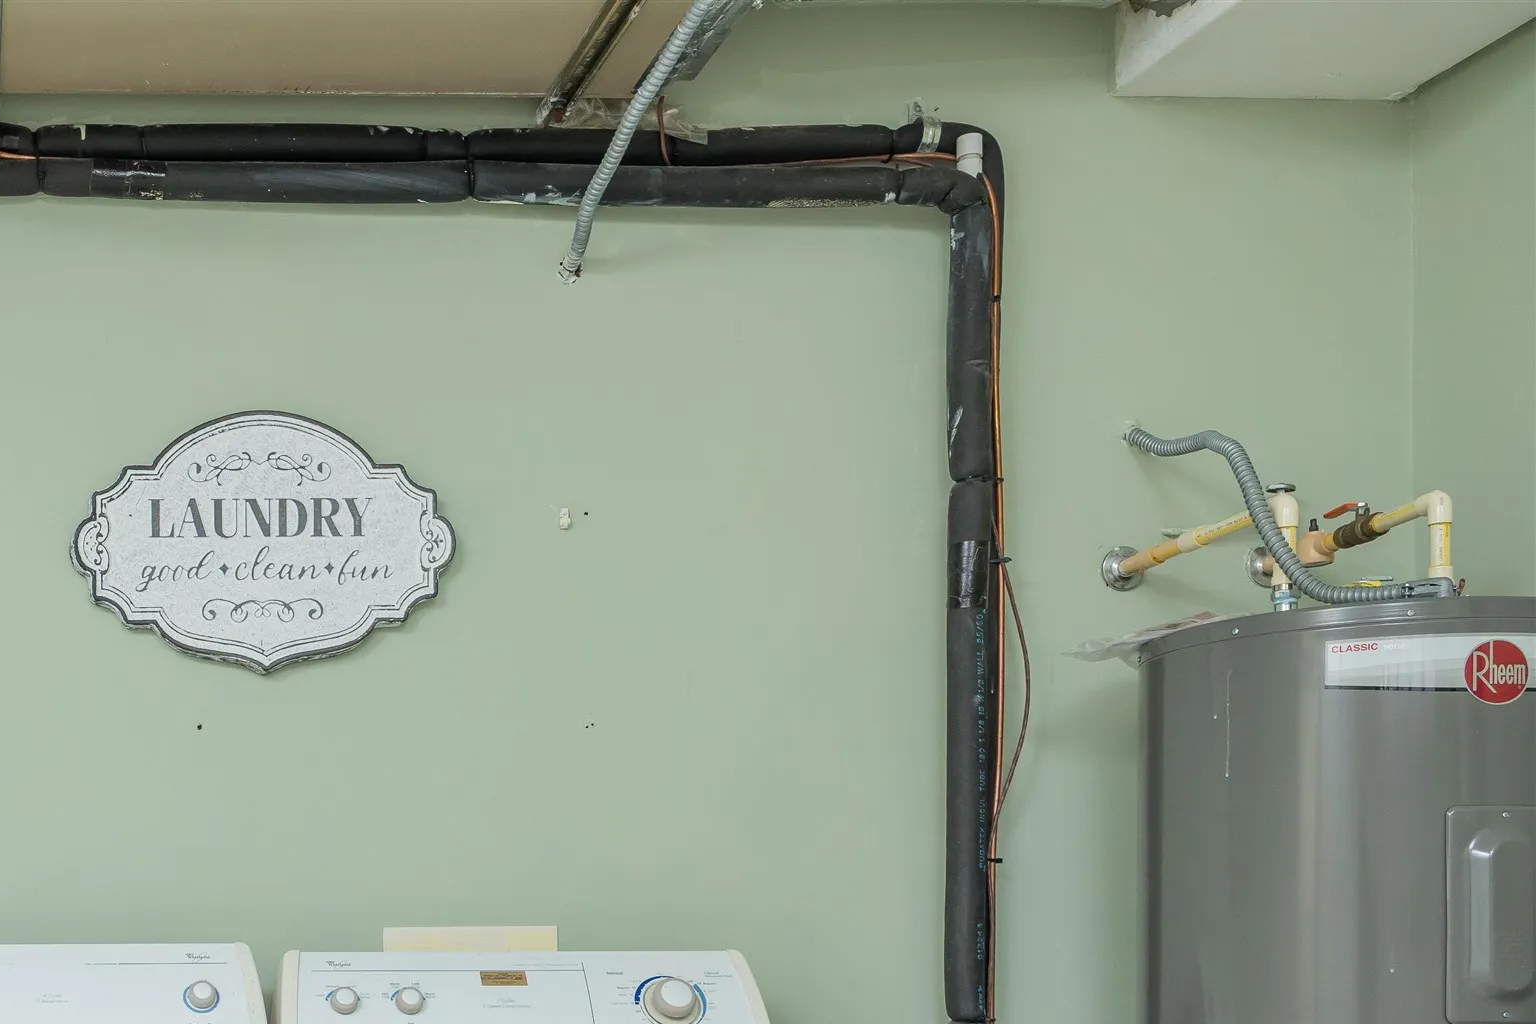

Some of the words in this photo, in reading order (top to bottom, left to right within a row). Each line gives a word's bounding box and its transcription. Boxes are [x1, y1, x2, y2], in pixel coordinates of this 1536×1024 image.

[147, 497, 373, 538] LAUNDRY
[135, 549, 213, 593] good
[234, 544, 321, 581] clean
[335, 549, 396, 587] fun
[975, 649, 985, 675] WALL
[1331, 642, 1379, 654] CLASSIC
[1472, 640, 1527, 694] Rheem
[976, 679, 985, 693] 1/2
